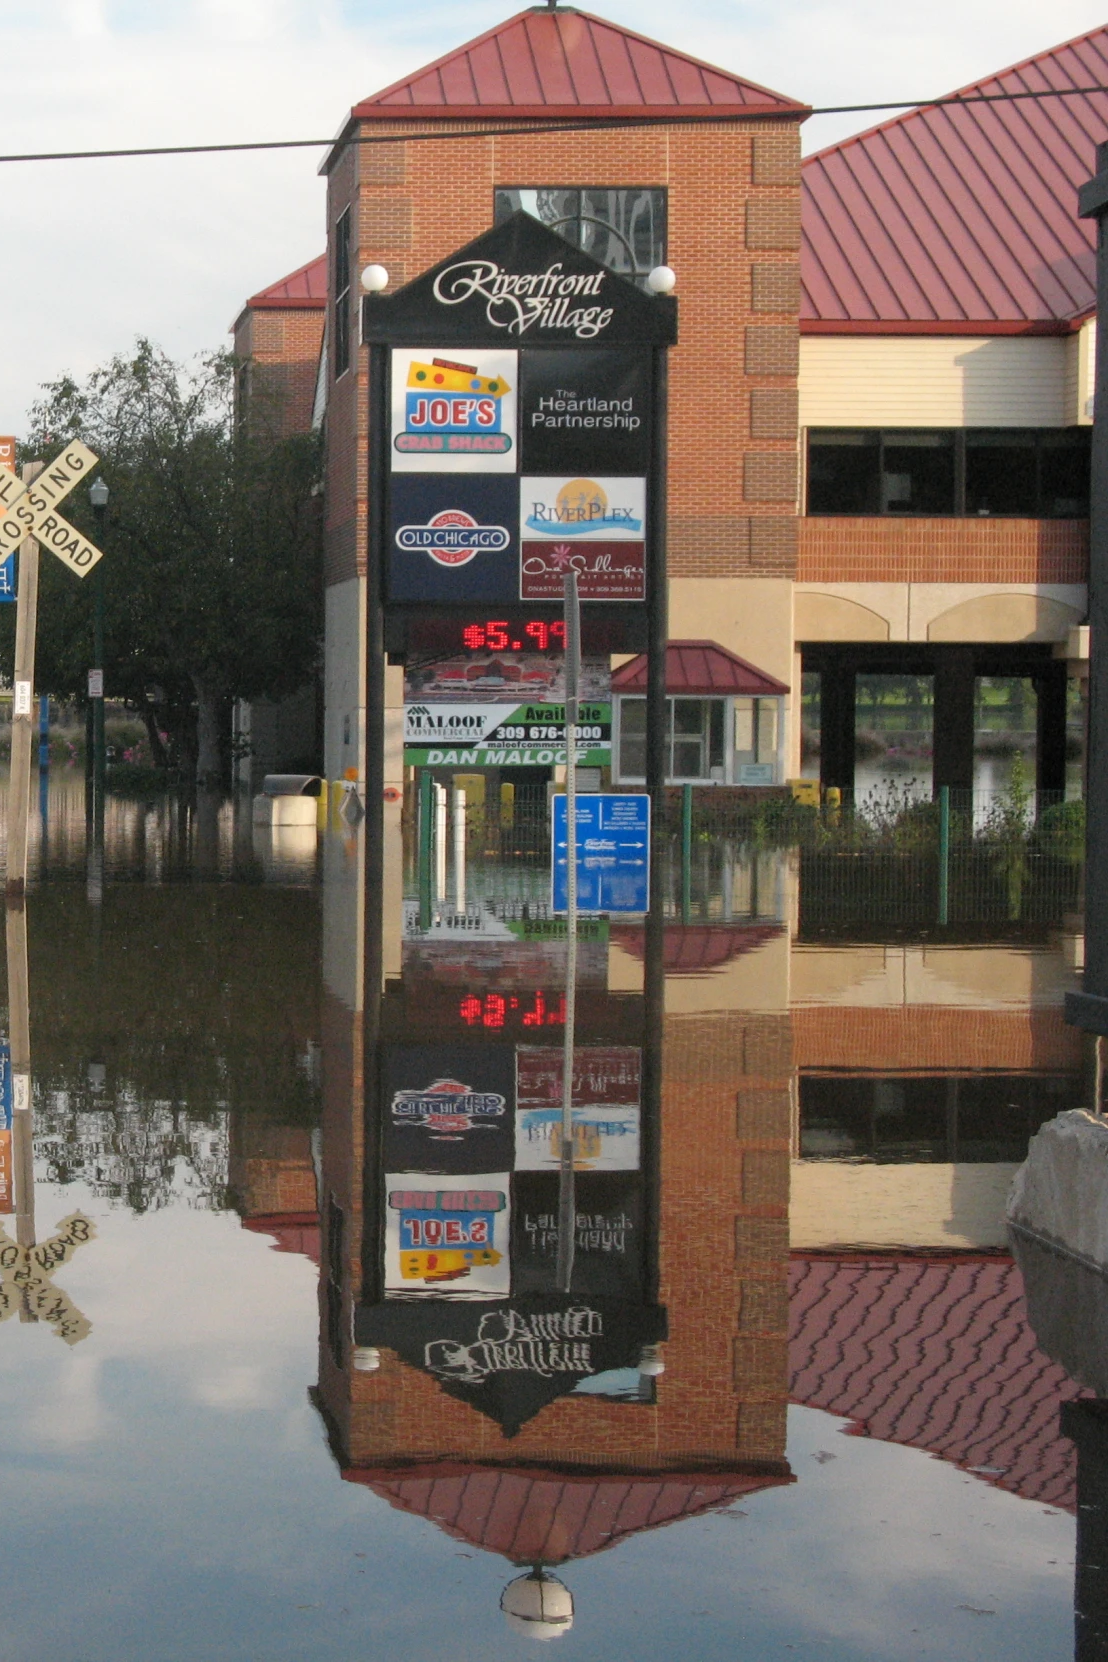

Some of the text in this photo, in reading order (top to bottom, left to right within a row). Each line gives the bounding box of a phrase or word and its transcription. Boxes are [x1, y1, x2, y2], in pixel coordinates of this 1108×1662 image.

[433, 260, 606, 305] Riverfront
[486, 293, 614, 338] Village
[556, 389, 577, 398] The
[539, 397, 633, 411] Heartland
[410, 398, 496, 426] JOE'S
[532, 413, 641, 431] Partnership
[397, 436, 507, 450] CRAB SHACK
[38, 515, 93, 567] ROAD
[402, 531, 504, 545] OLD CHICAGO
[464, 621, 568, 650] $5.99
[525, 706, 601, 720] Availble
[407, 715, 488, 728] MALOOF
[406, 728, 485, 736] COMMERCIAL
[496, 726, 525, 739] 309
[427, 750, 478, 764] DAN
